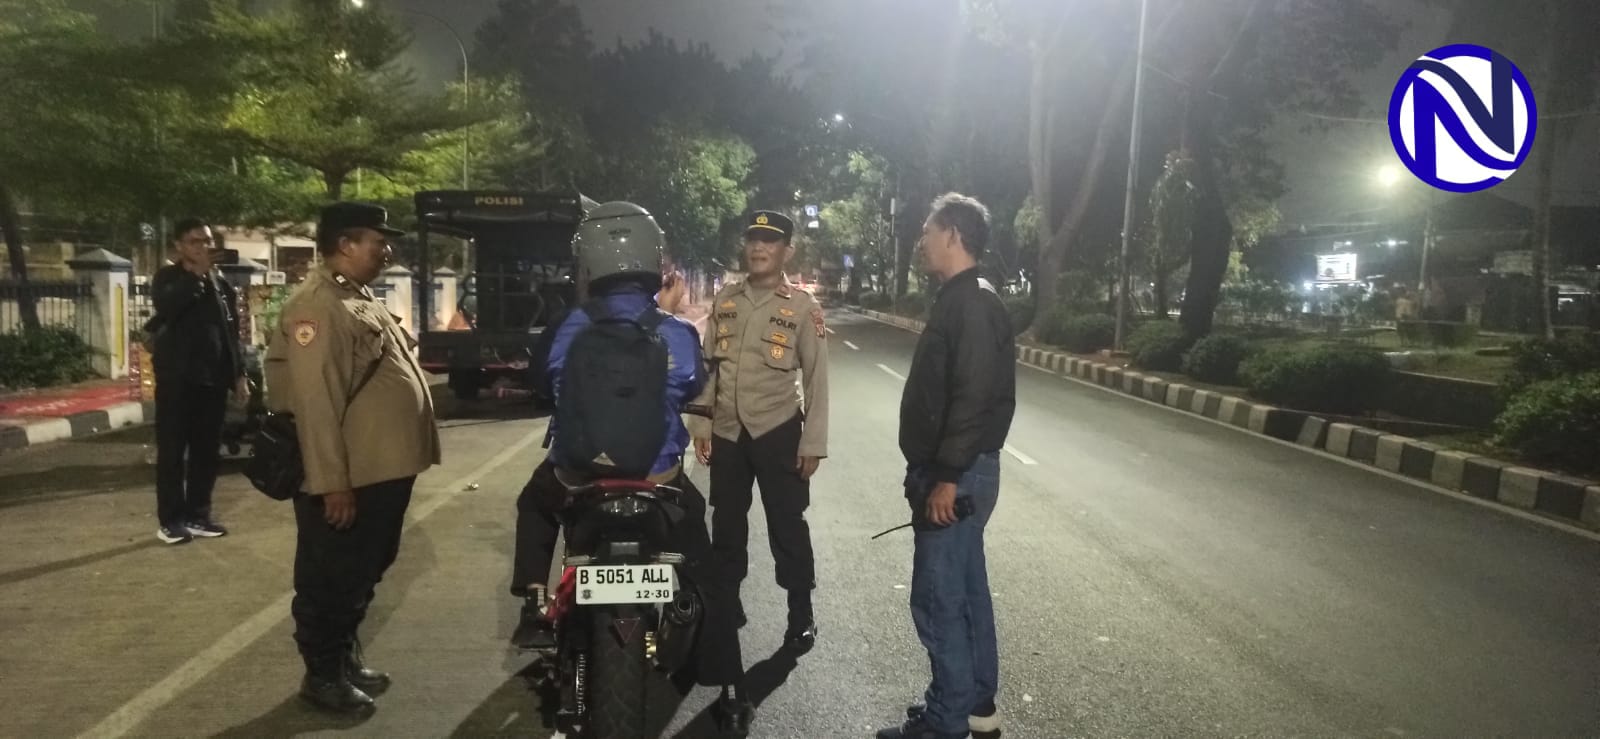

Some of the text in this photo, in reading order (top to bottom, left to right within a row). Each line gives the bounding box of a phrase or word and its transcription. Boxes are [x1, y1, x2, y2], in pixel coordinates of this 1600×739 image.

[475, 196, 523, 205] POLISI
[769, 316, 797, 330] POLRI
[580, 568, 669, 584] B 5051 ALL
